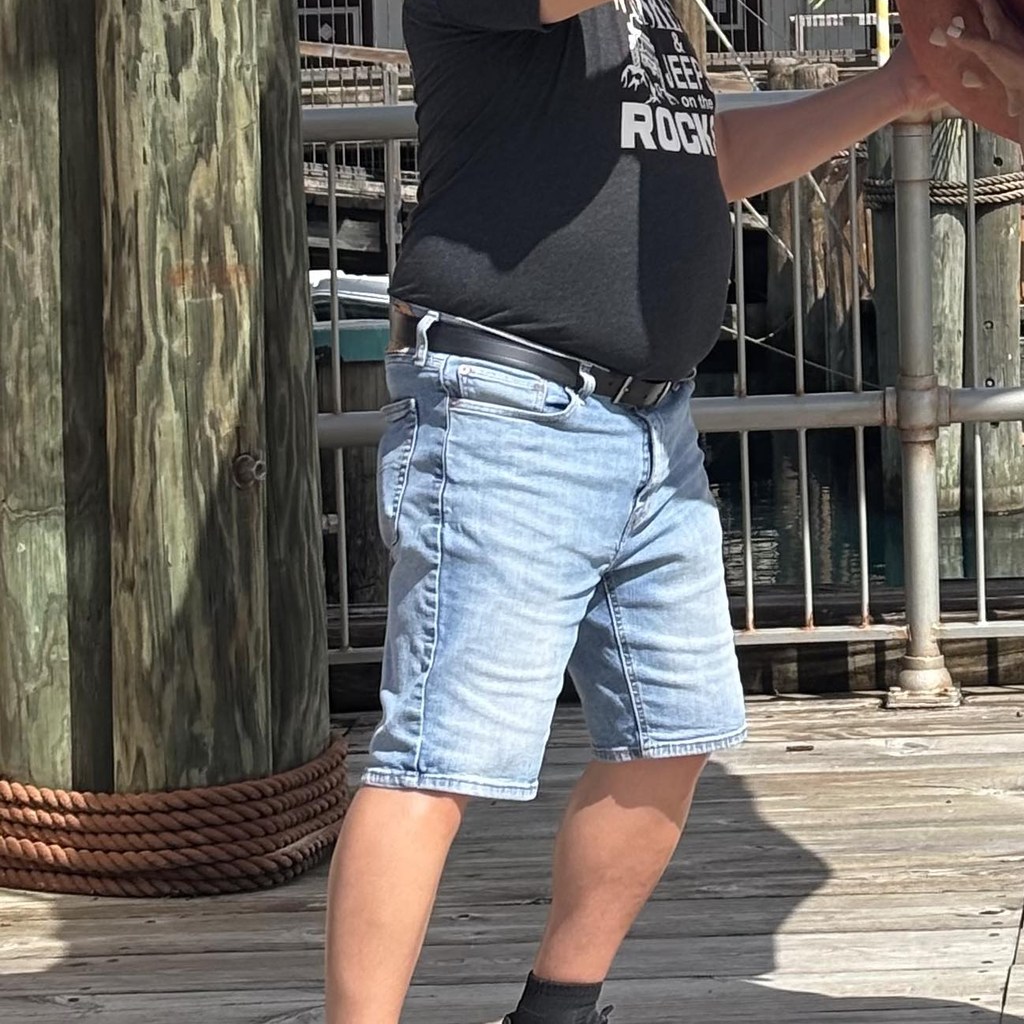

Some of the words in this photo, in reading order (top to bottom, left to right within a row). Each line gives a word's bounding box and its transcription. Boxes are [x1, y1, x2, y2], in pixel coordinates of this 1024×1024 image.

[662, 54, 712, 92] JEEP
[681, 95, 698, 109] on
[698, 94, 714, 110] the
